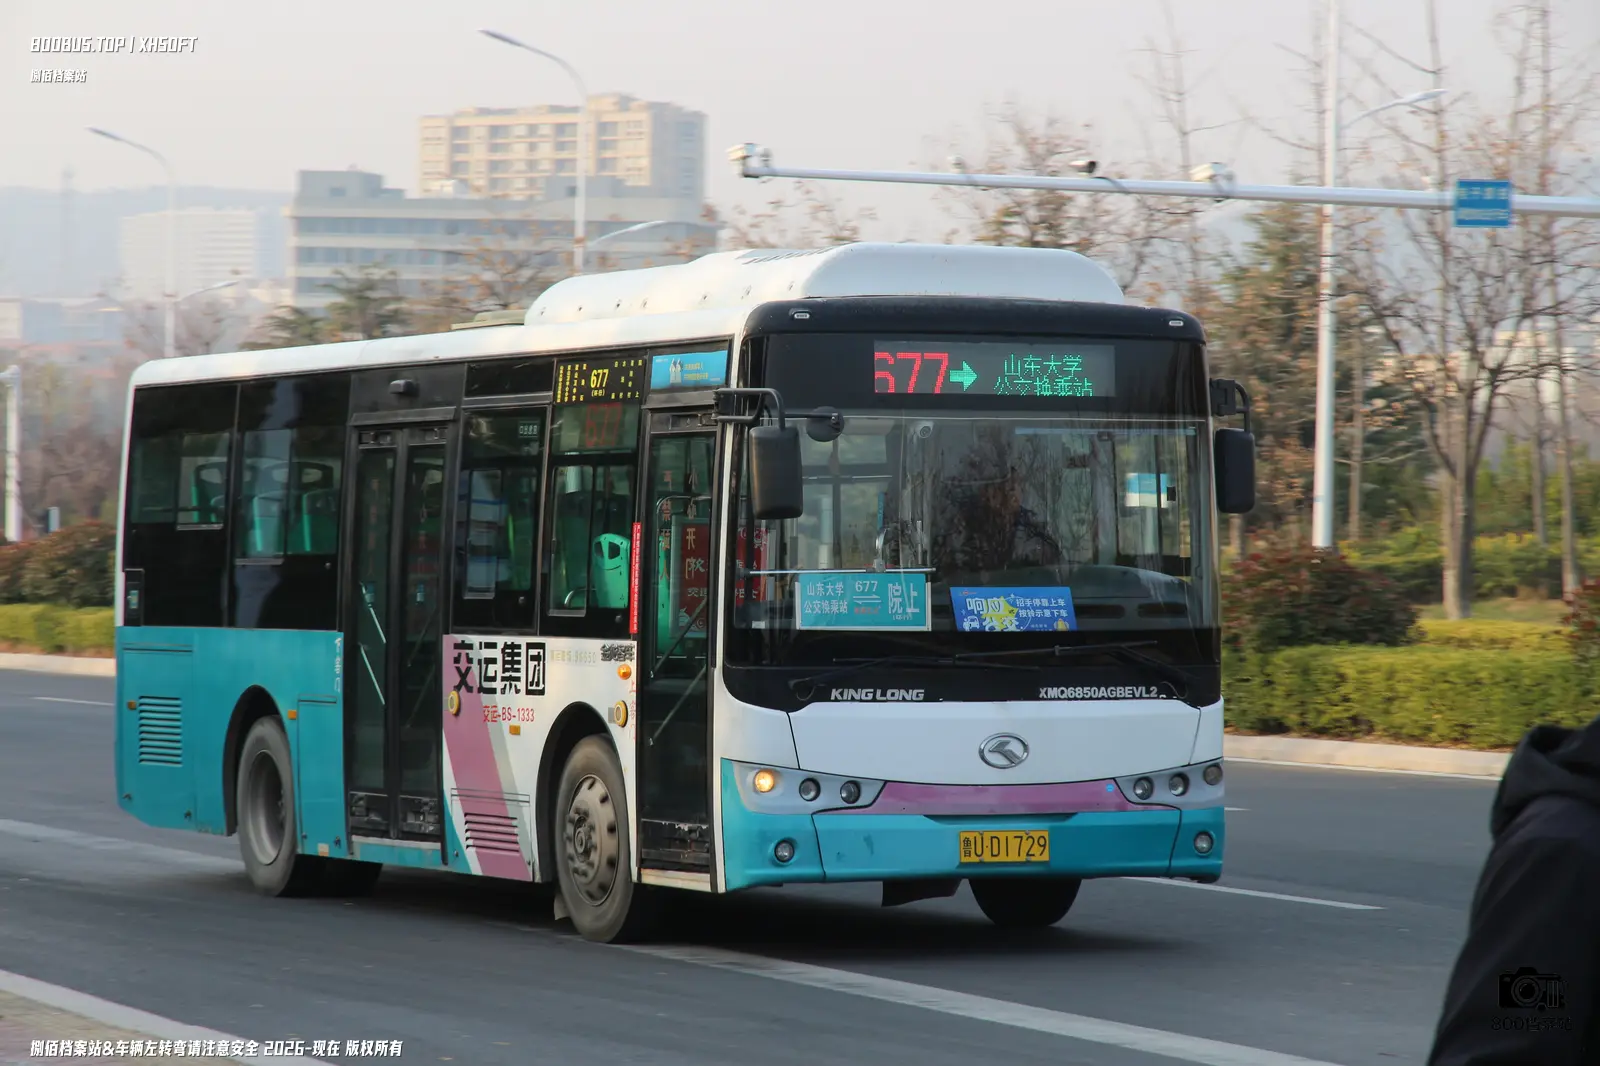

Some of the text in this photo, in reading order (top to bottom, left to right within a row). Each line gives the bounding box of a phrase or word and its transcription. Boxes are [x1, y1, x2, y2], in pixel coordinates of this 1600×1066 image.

[874, 352, 949, 394] 677
[1004, 354, 1083, 378] 山东大学
[590, 368, 609, 388] 677
[994, 375, 1093, 397] 公交换乘站
[585, 402, 623, 448] 677
[806, 582, 845, 597] 山东大学
[855, 580, 878, 592] 677
[803, 599, 848, 614] 公交换乘站
[887, 582, 920, 614] 院上
[1016, 598, 1066, 607] 招手停靠上车
[1018, 609, 1068, 618] 按铃示意下车
[453, 640, 546, 696] 交运集团
[830, 688, 925, 701] KING LONG
[1039, 686, 1158, 699] XMQ6850AGBEVL2
[482, 705, 535, 723] 交运-BS-1333
